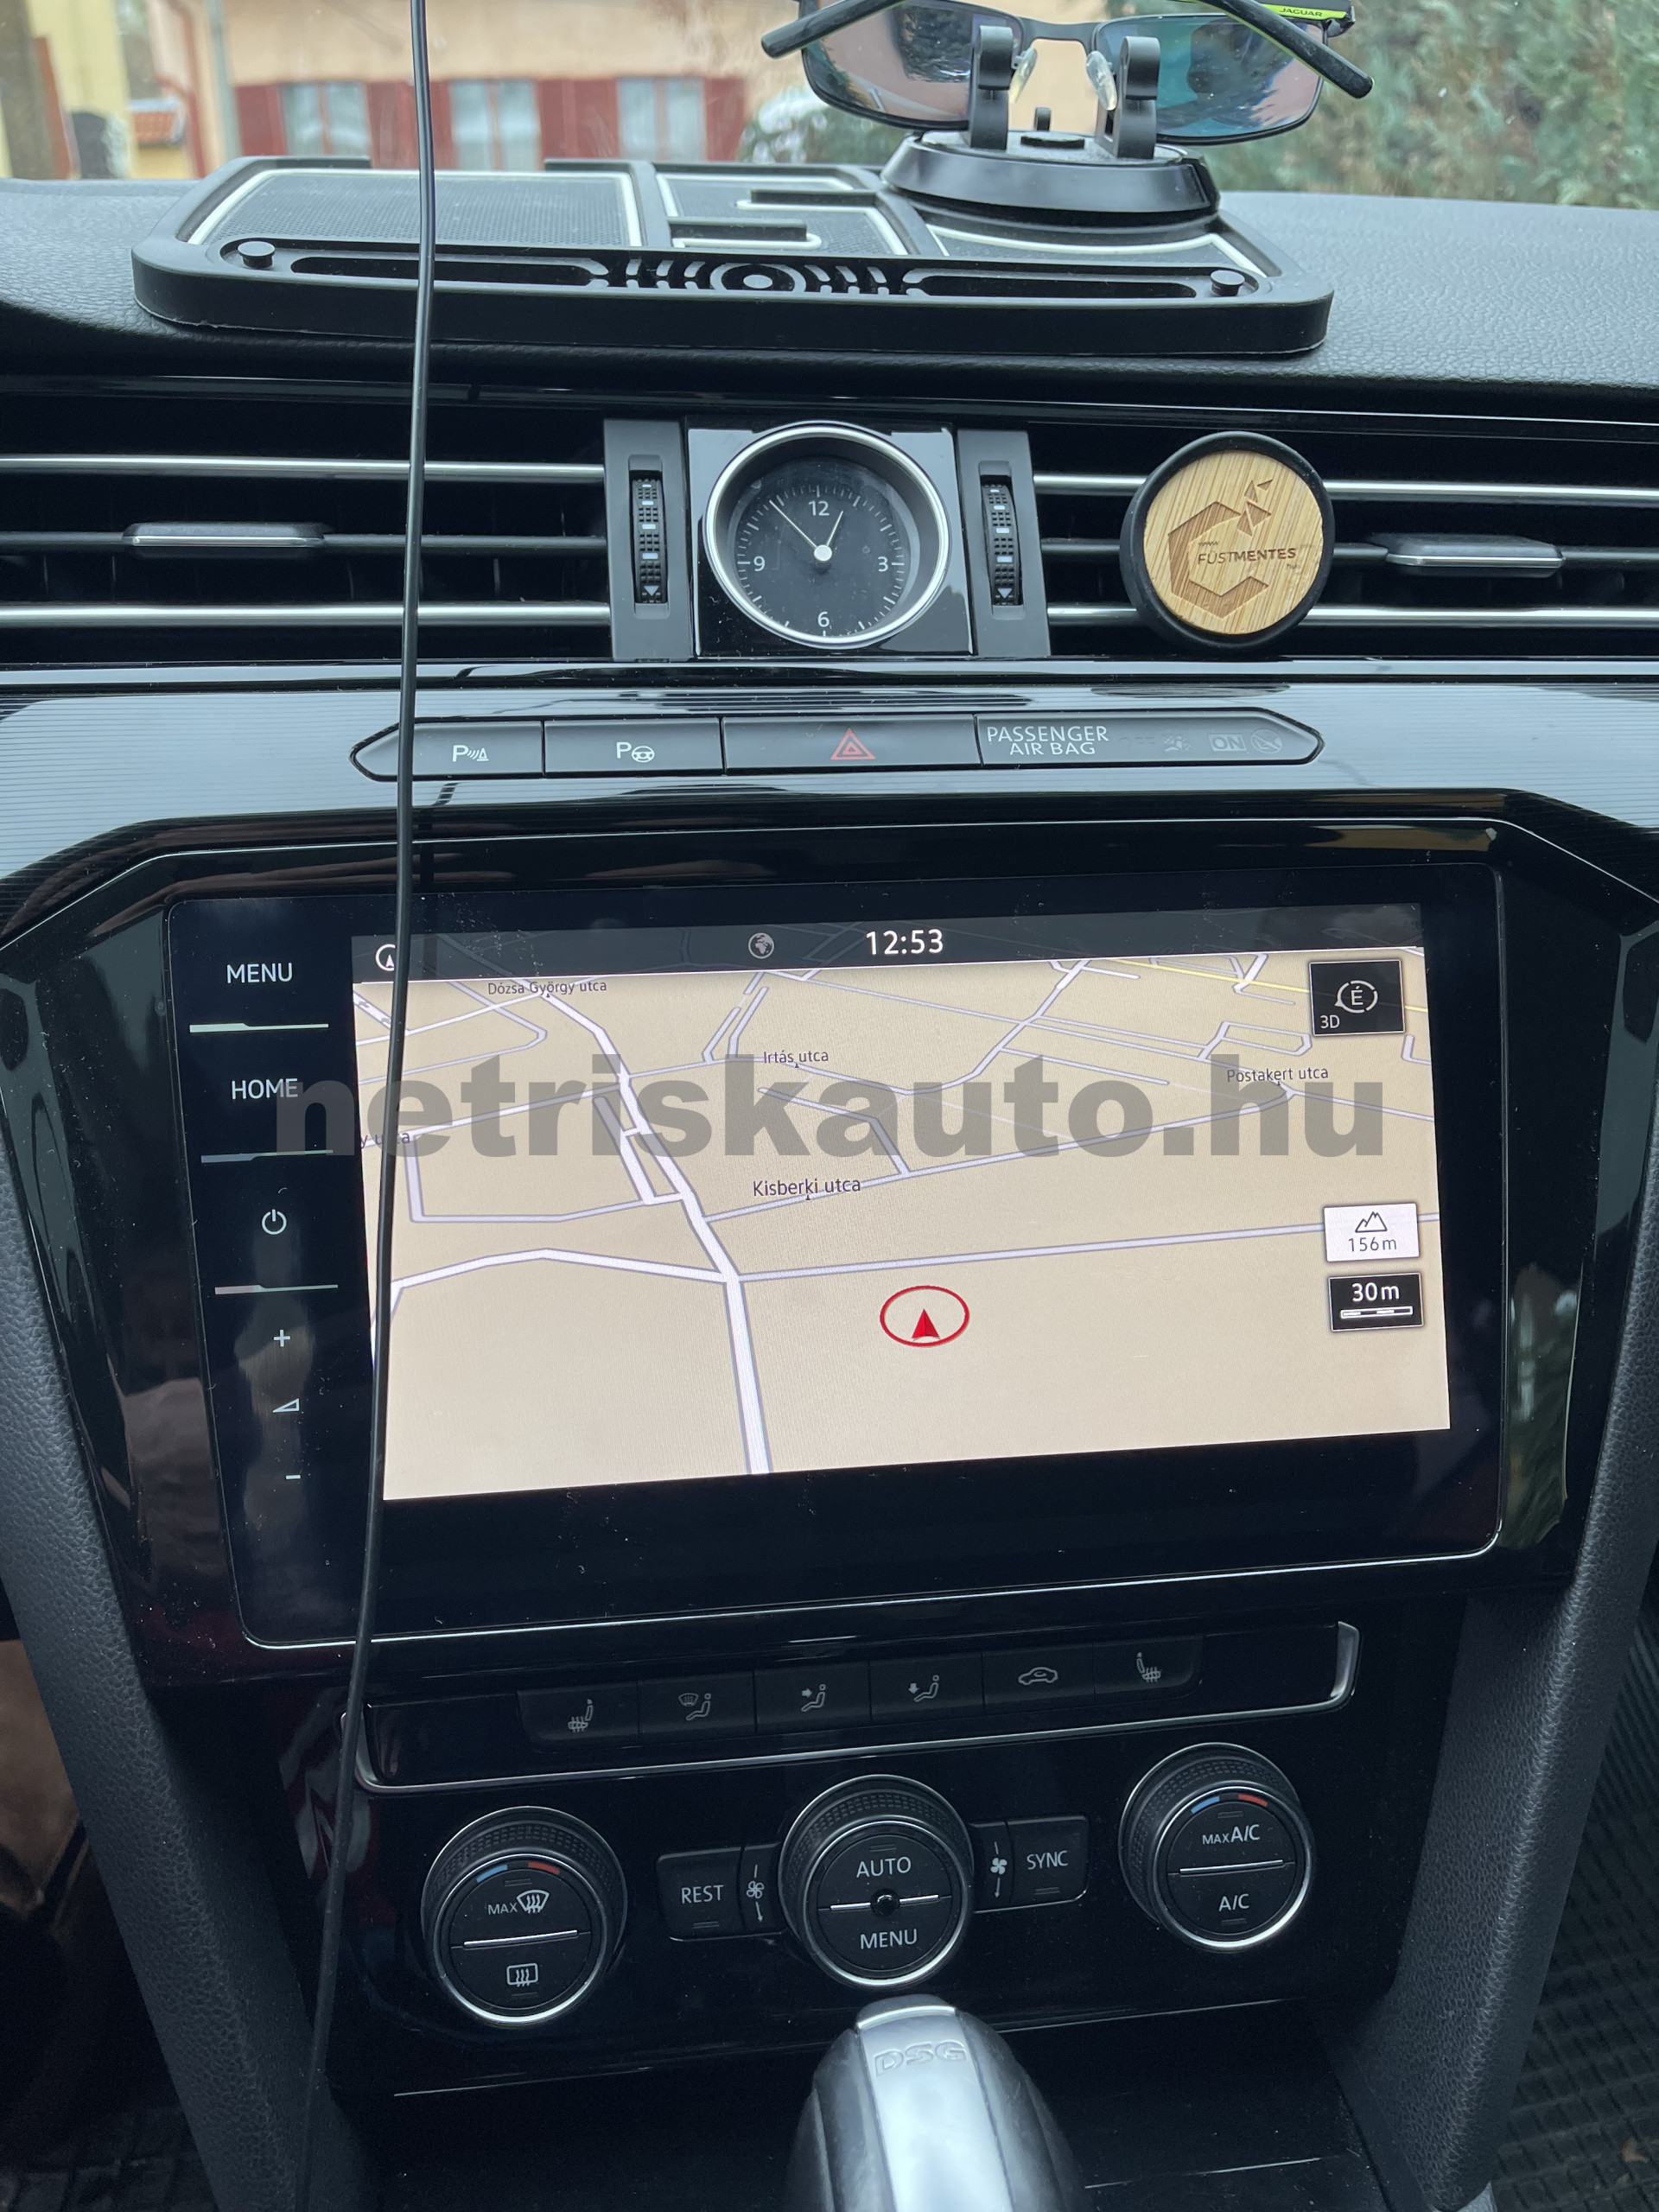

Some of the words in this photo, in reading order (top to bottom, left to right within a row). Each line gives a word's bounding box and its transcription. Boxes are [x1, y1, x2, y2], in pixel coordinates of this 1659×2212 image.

[1280, 8, 1323, 16] JAGUAR
[808, 501, 830, 516] 12
[753, 556, 766, 571] 9
[877, 556, 888, 572] 3
[1198, 548, 1296, 564] FÜSTMENTES
[817, 611, 830, 627] 6
[987, 726, 1109, 743] PASSENGER
[1009, 742, 1042, 755] AIR
[1052, 741, 1096, 755] BAG
[1211, 736, 1244, 750] ON
[866, 928, 944, 956] 12:53
[226, 962, 294, 984] MENU
[488, 982, 524, 996] Dózsa
[530, 982, 575, 995] György
[580, 980, 607, 993] utca
[1319, 1014, 1340, 1029] 3D
[763, 1050, 794, 1064] Irtás
[798, 1050, 830, 1063] utca
[1226, 1068, 1294, 1083] Postakert
[1298, 1066, 1330, 1080] utca
[232, 1078, 299, 1100] HOME
[753, 1178, 820, 1197] Kisberki
[824, 1178, 862, 1193] utca
[856, 1856, 912, 1878] AUTO
[1027, 1850, 1069, 1870] SYNC
[681, 1885, 724, 1904] REST
[1218, 1893, 1250, 1912] A/C
[486, 1902, 518, 1916] MAX
[860, 1928, 918, 1950] MENU
[874, 2040, 968, 2075] DSG
